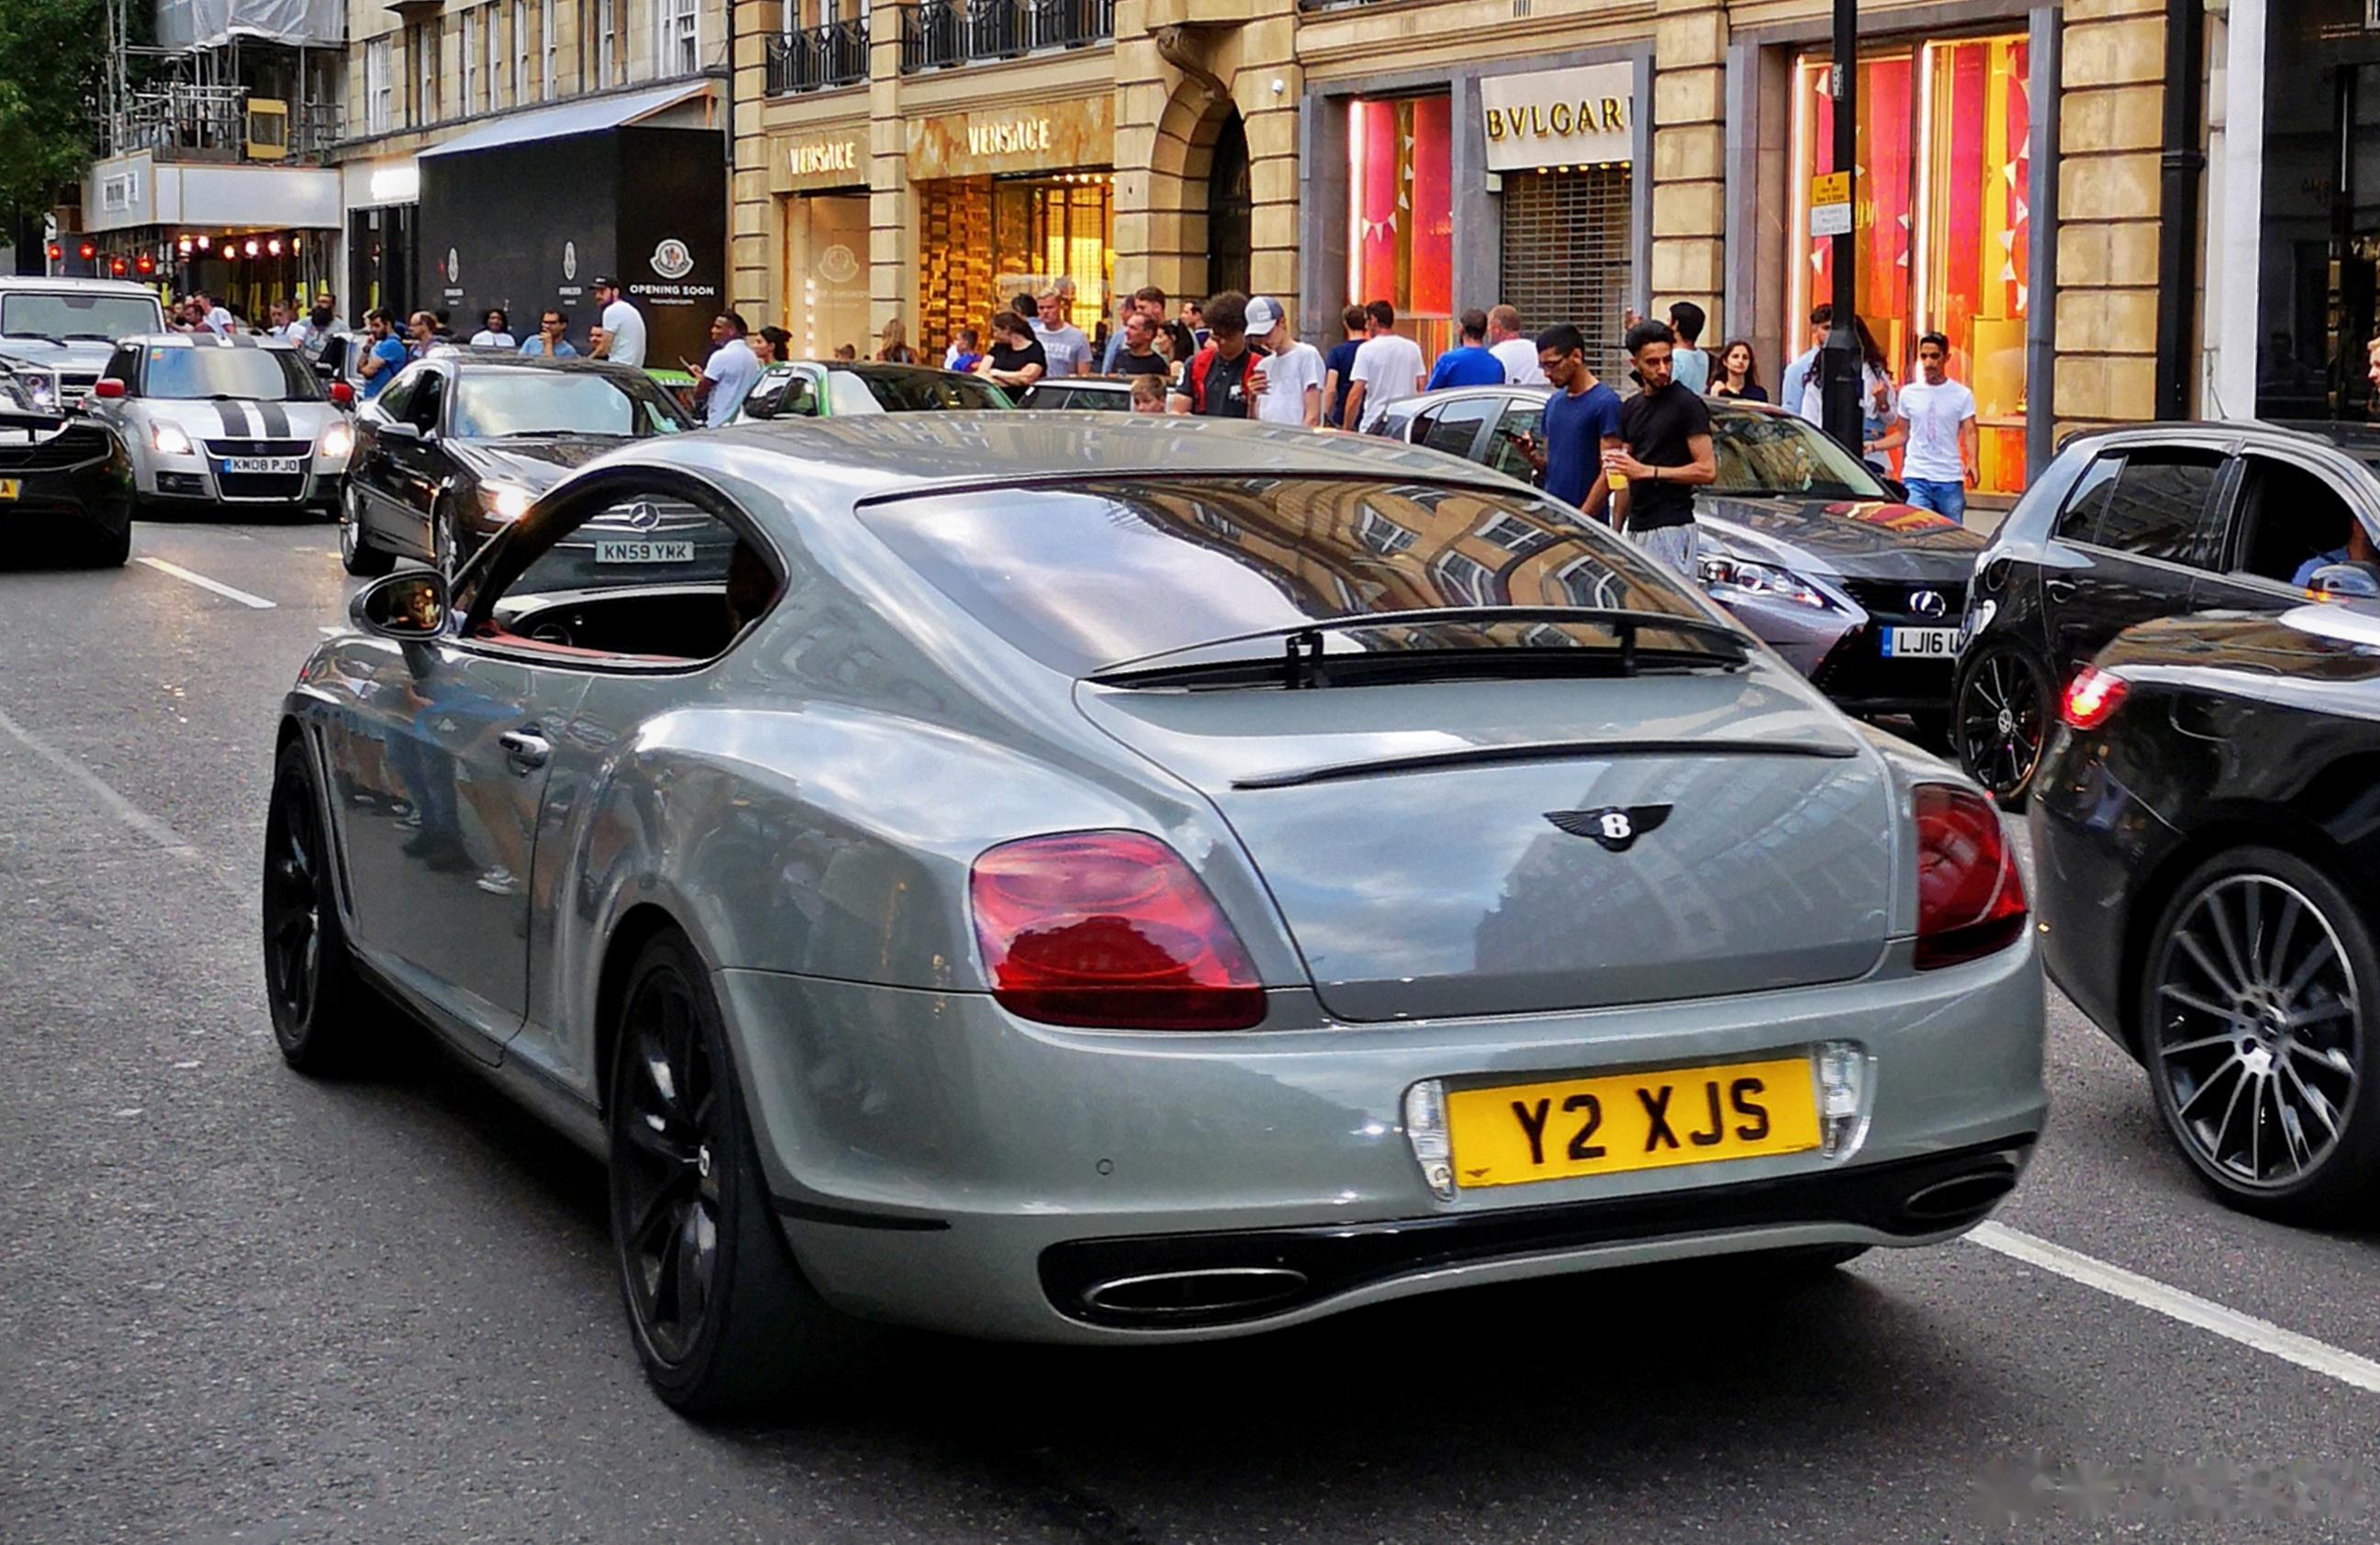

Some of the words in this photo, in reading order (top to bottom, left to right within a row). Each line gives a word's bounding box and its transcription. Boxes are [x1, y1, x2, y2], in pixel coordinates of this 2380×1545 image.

[967, 117, 1051, 156] VERSACE
[789, 140, 856, 174] VERSACE
[629, 284, 680, 295] OPENING
[682, 285, 715, 296] SOON
[233, 459, 269, 471] KN08
[604, 544, 651, 559] KN59
[1899, 631, 1943, 654] LJ16
[1511, 1094, 1606, 1164] Y2
[1636, 1078, 1770, 1153] XJS
